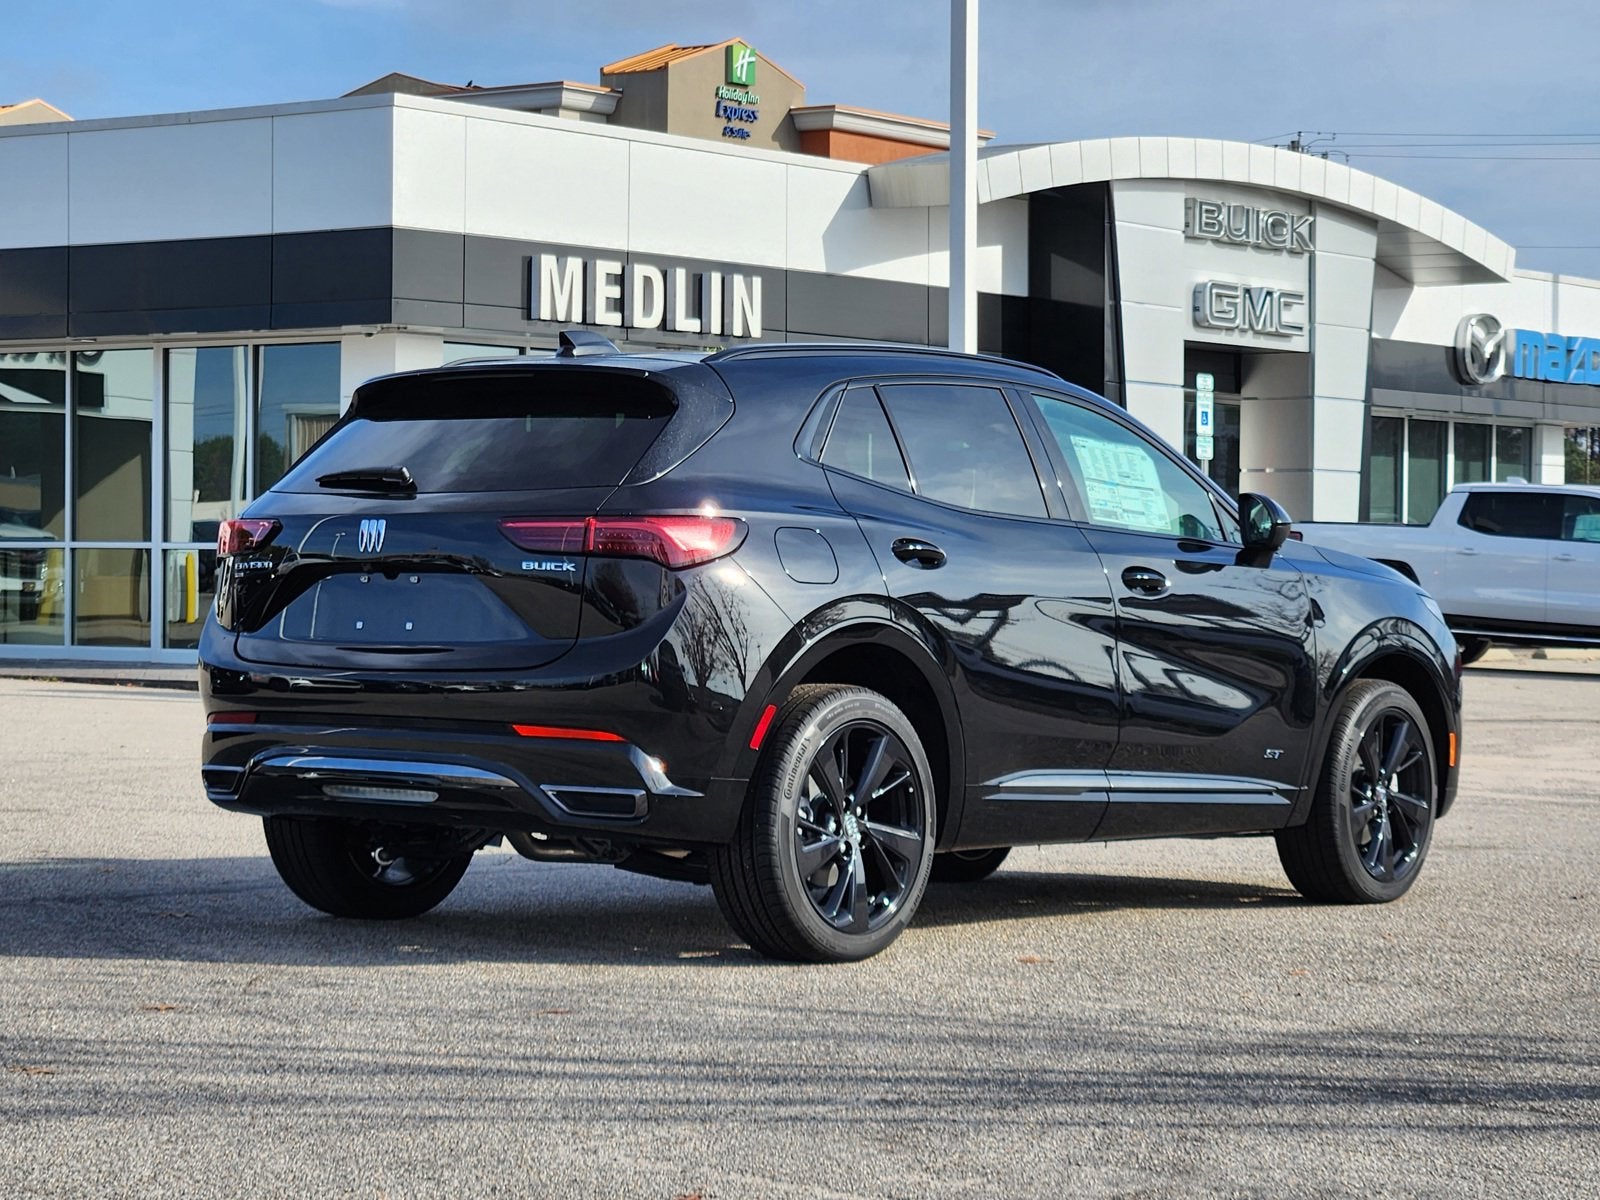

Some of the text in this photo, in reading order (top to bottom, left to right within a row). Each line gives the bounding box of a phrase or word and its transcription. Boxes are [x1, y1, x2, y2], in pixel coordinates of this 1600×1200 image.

[718, 86, 760, 104] Holiday Inn
[718, 102, 758, 122] Express
[1192, 199, 1315, 251] BUICK
[535, 253, 762, 339] MEDLIN
[1198, 280, 1305, 337] GMC
[521, 561, 577, 572] BUICK
[783, 743, 808, 800] Continental
